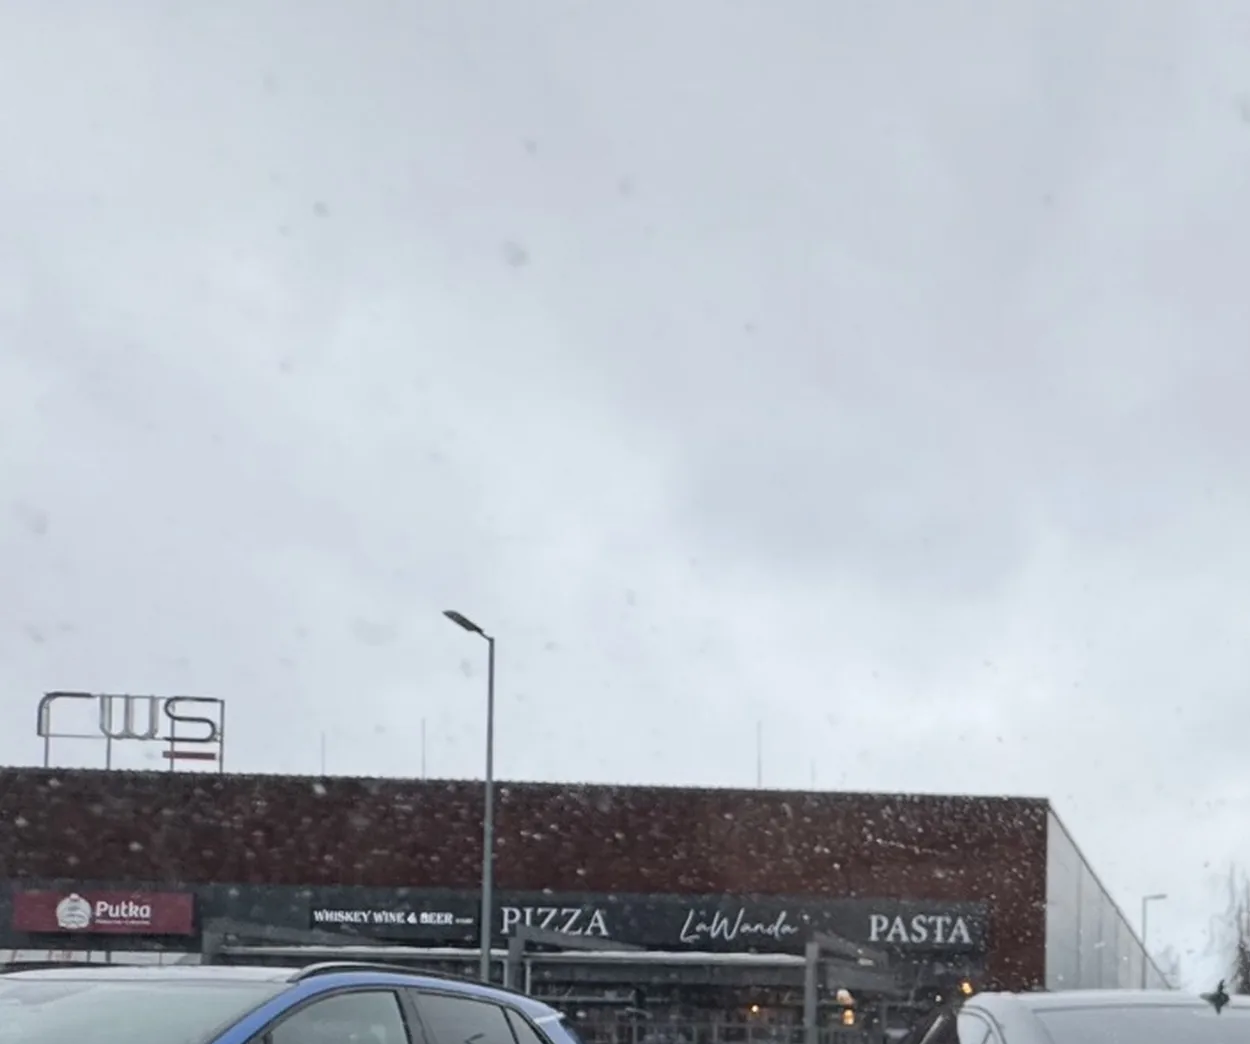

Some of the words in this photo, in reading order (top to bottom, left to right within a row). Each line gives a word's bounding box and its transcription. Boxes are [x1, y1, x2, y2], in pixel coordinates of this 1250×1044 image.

[95, 900, 151, 918] Putka
[313, 909, 371, 923] WHISKEY
[372, 910, 405, 924] WINE
[407, 912, 417, 924] &
[419, 912, 453, 925] BEER
[500, 906, 609, 936] PIZZA
[868, 914, 973, 944] PASTA
